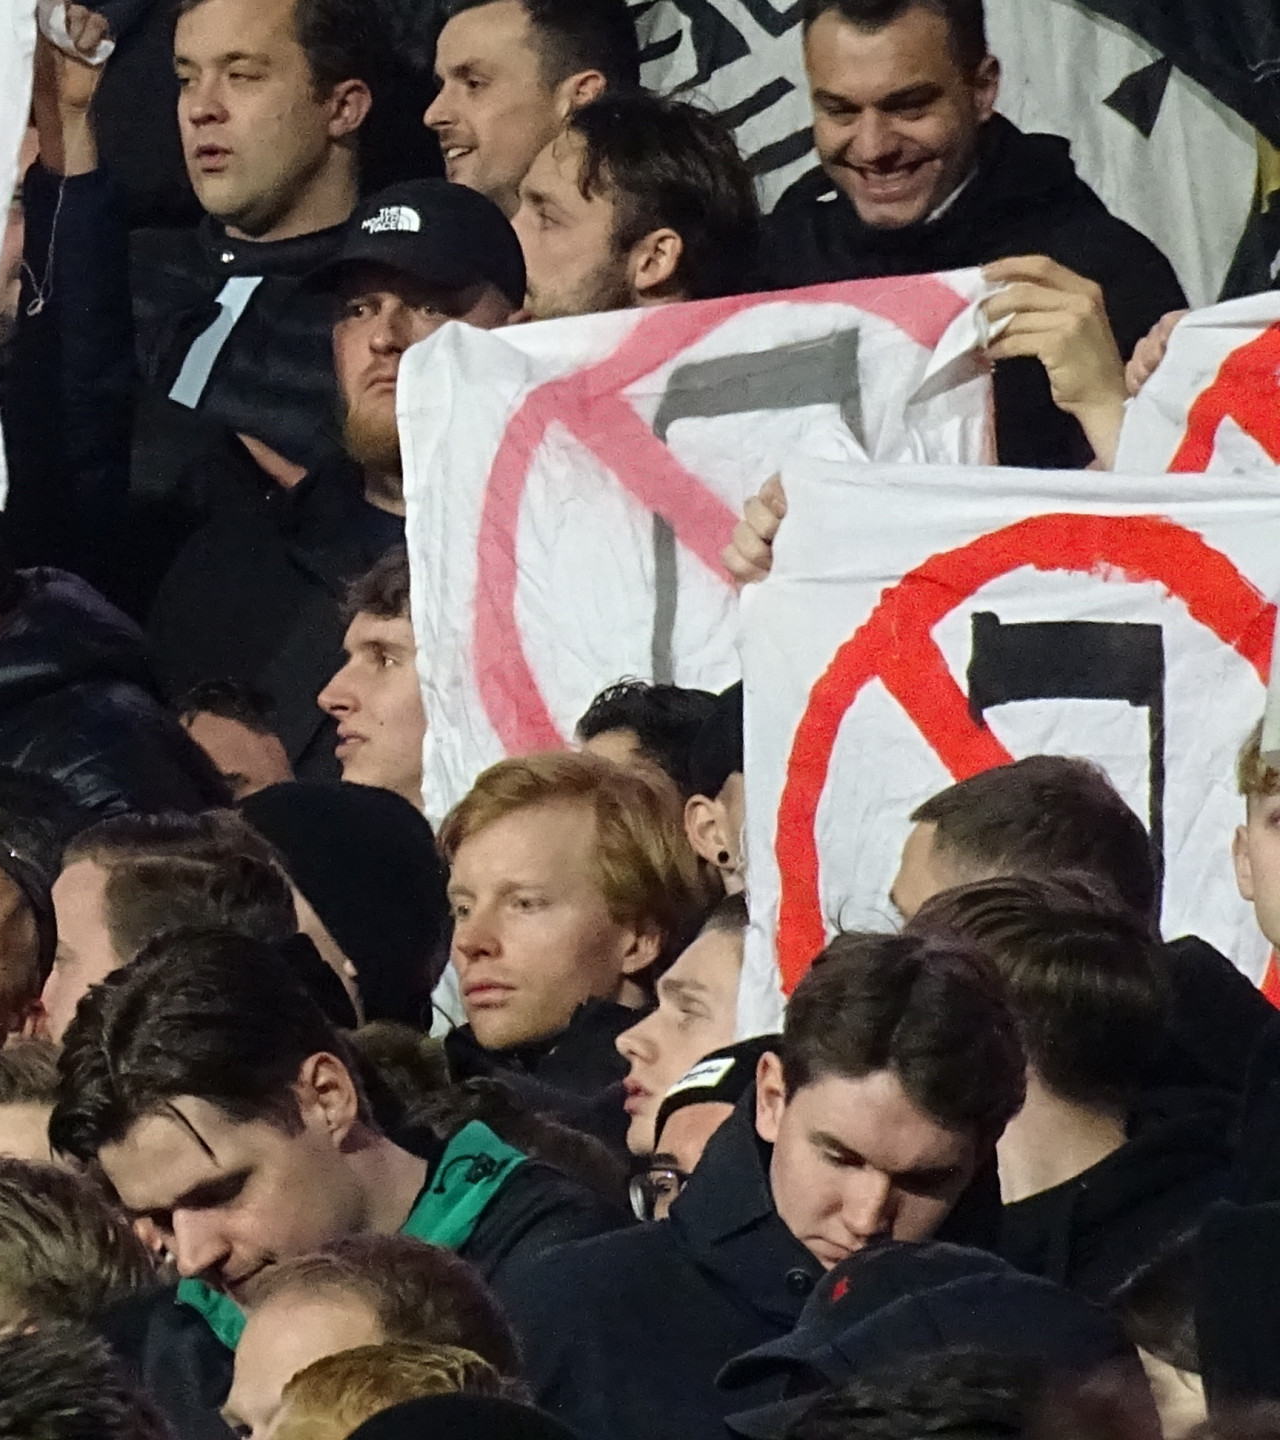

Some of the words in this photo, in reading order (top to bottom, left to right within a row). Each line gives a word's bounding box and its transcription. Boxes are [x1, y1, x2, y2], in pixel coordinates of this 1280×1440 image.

[380, 206, 400, 217] THE
[361, 214, 400, 229] NORTH
[369, 222, 399, 234] FACE
